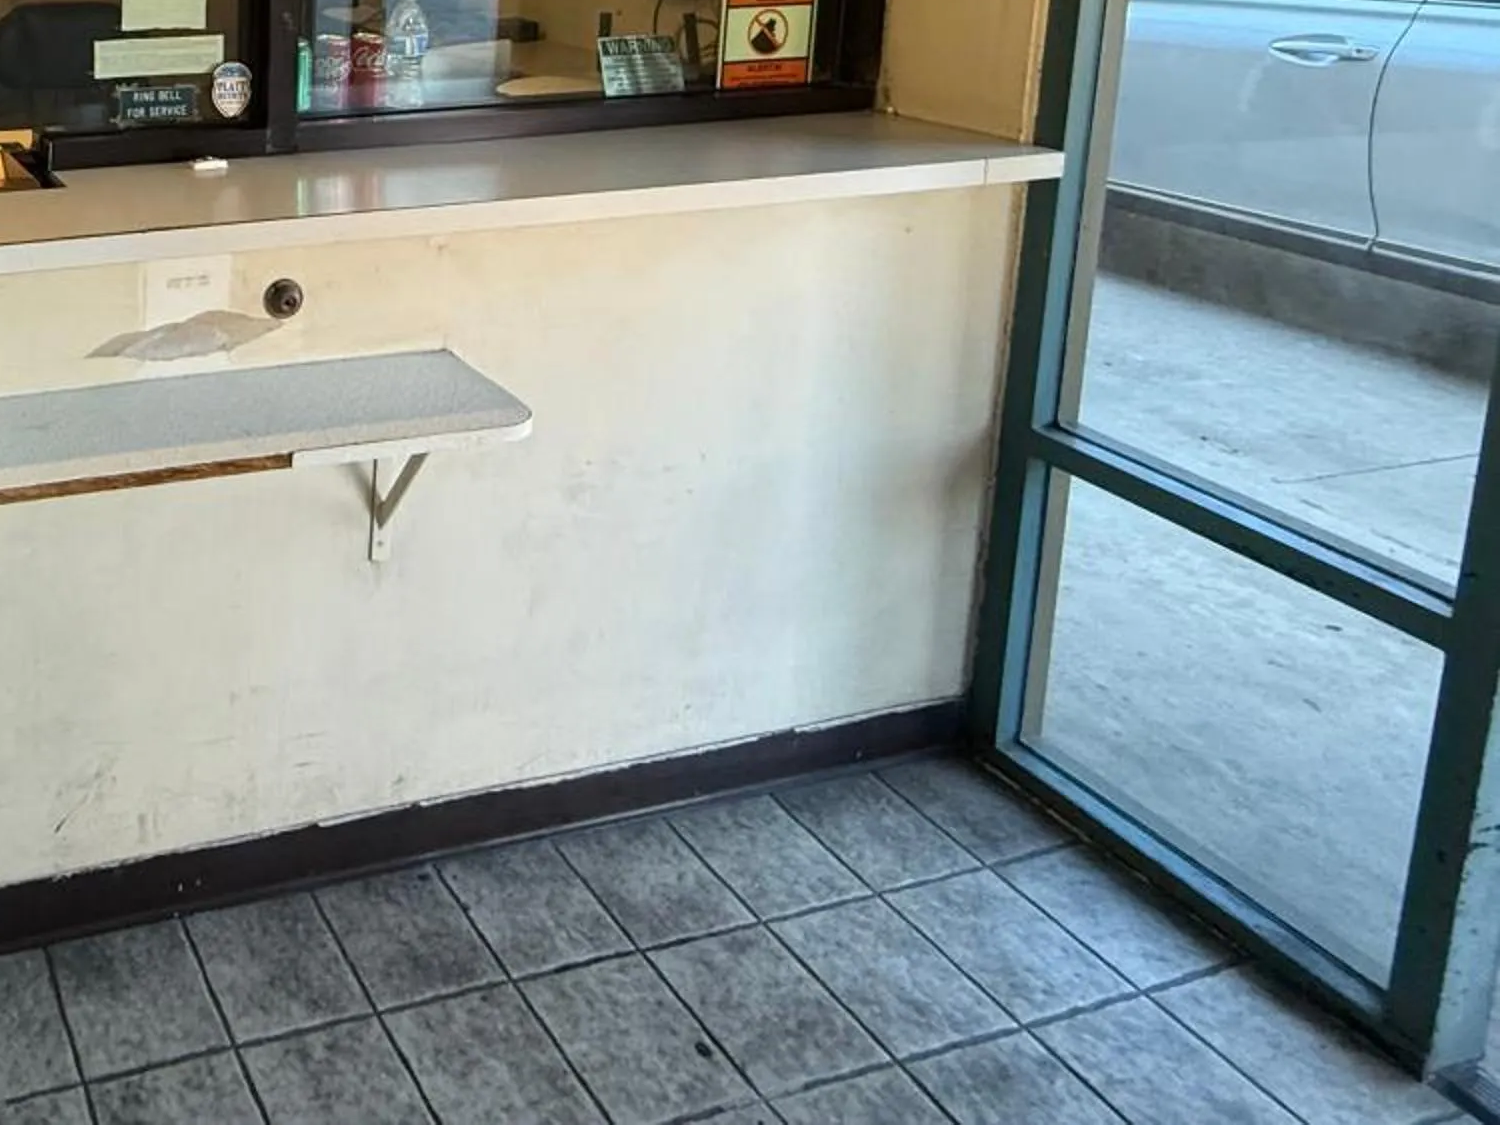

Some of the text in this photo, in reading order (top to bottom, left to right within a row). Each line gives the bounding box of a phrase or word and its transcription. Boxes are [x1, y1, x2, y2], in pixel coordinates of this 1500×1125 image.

[133, 89, 182, 102] RING BELL
[127, 104, 188, 119] FOR SERVICE
